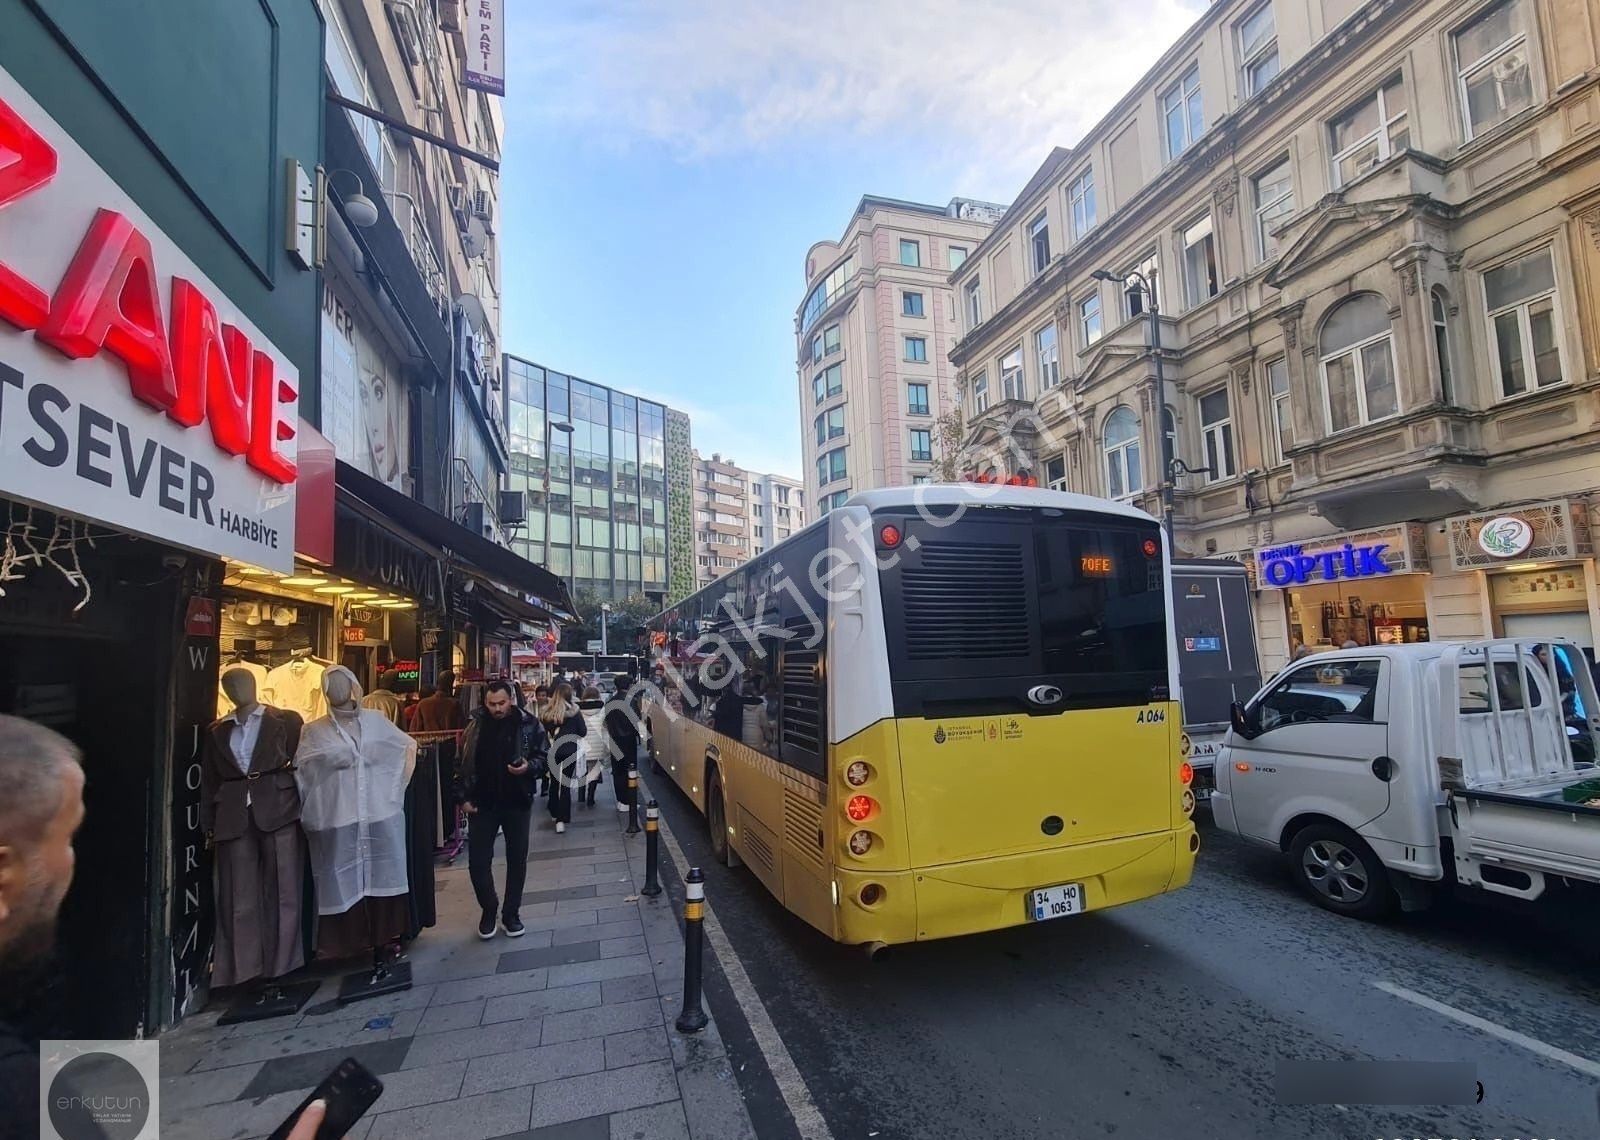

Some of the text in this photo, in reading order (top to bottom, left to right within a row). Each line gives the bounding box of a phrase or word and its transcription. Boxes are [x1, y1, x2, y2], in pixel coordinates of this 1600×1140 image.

[219, 507, 278, 550] HARBİYE
[1266, 543, 1393, 586] OPTİK
[1136, 709, 1165, 724] A 064
[1036, 887, 1076, 904] 34 HO
[1051, 901, 1072, 914] 1063
